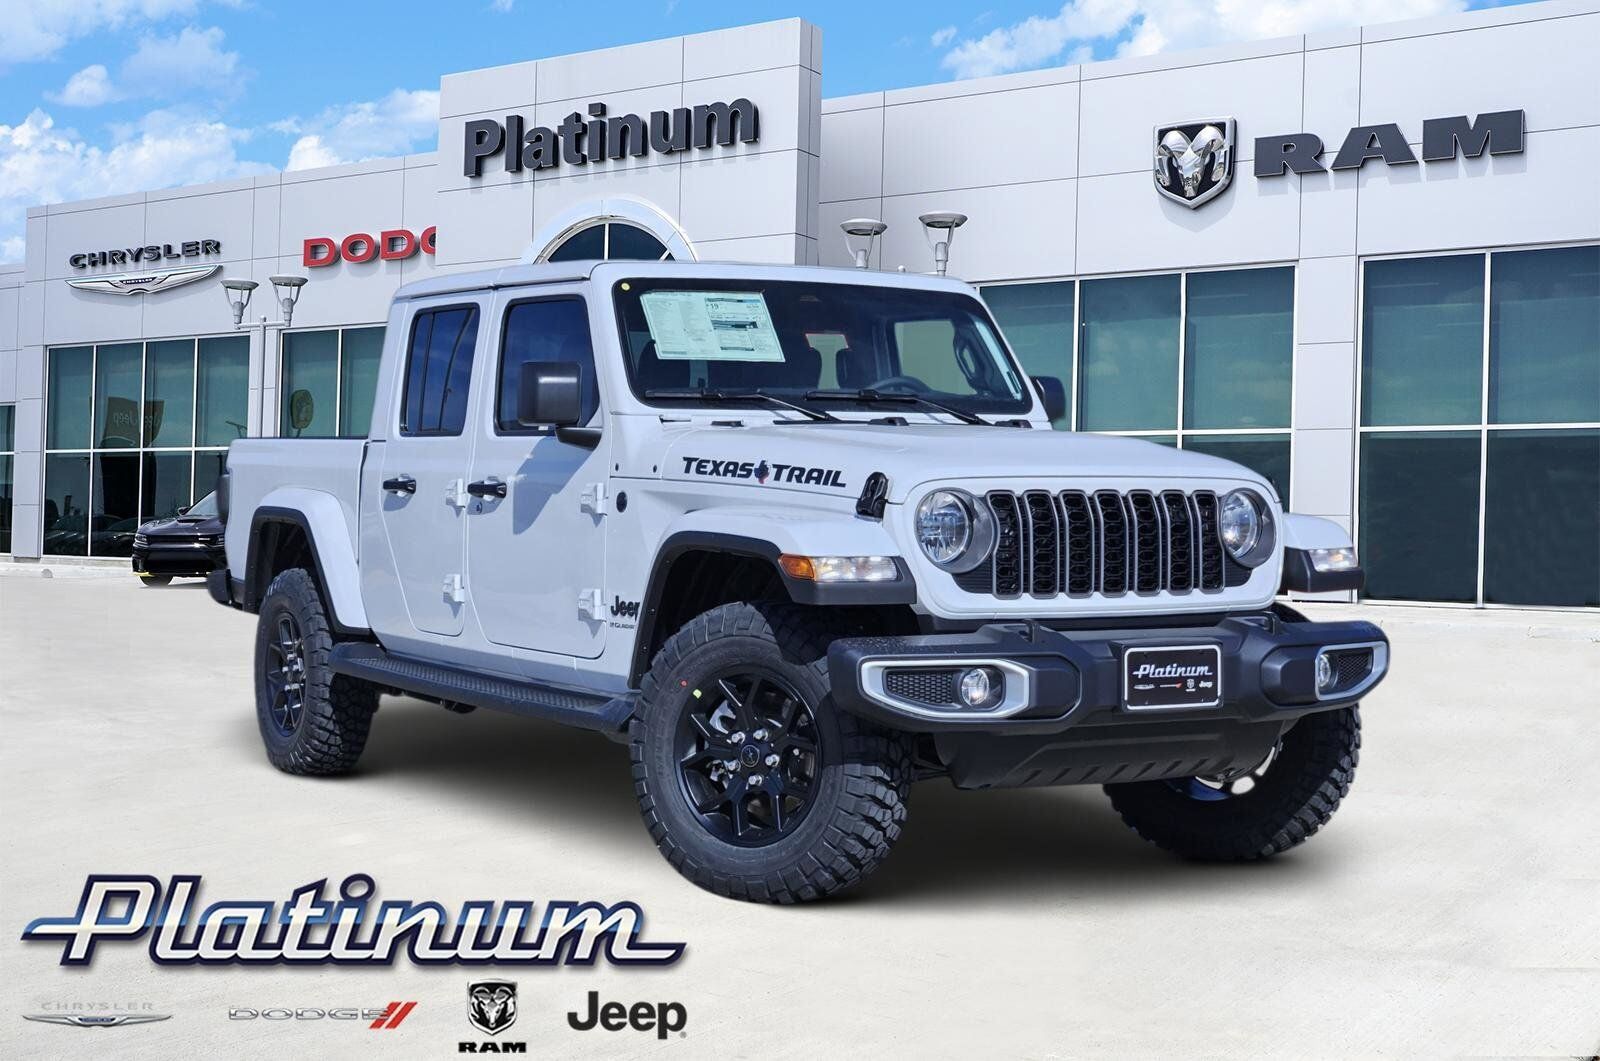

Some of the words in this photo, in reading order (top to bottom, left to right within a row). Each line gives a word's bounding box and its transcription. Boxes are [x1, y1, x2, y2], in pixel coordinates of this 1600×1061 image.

[463, 97, 761, 178] Platinum
[1253, 109, 1525, 177] RAM
[69, 239, 221, 269] CHRYSLER
[682, 456, 755, 479] TEXAS
[772, 463, 847, 488] TRAIL
[1132, 663, 1213, 679] Platinum
